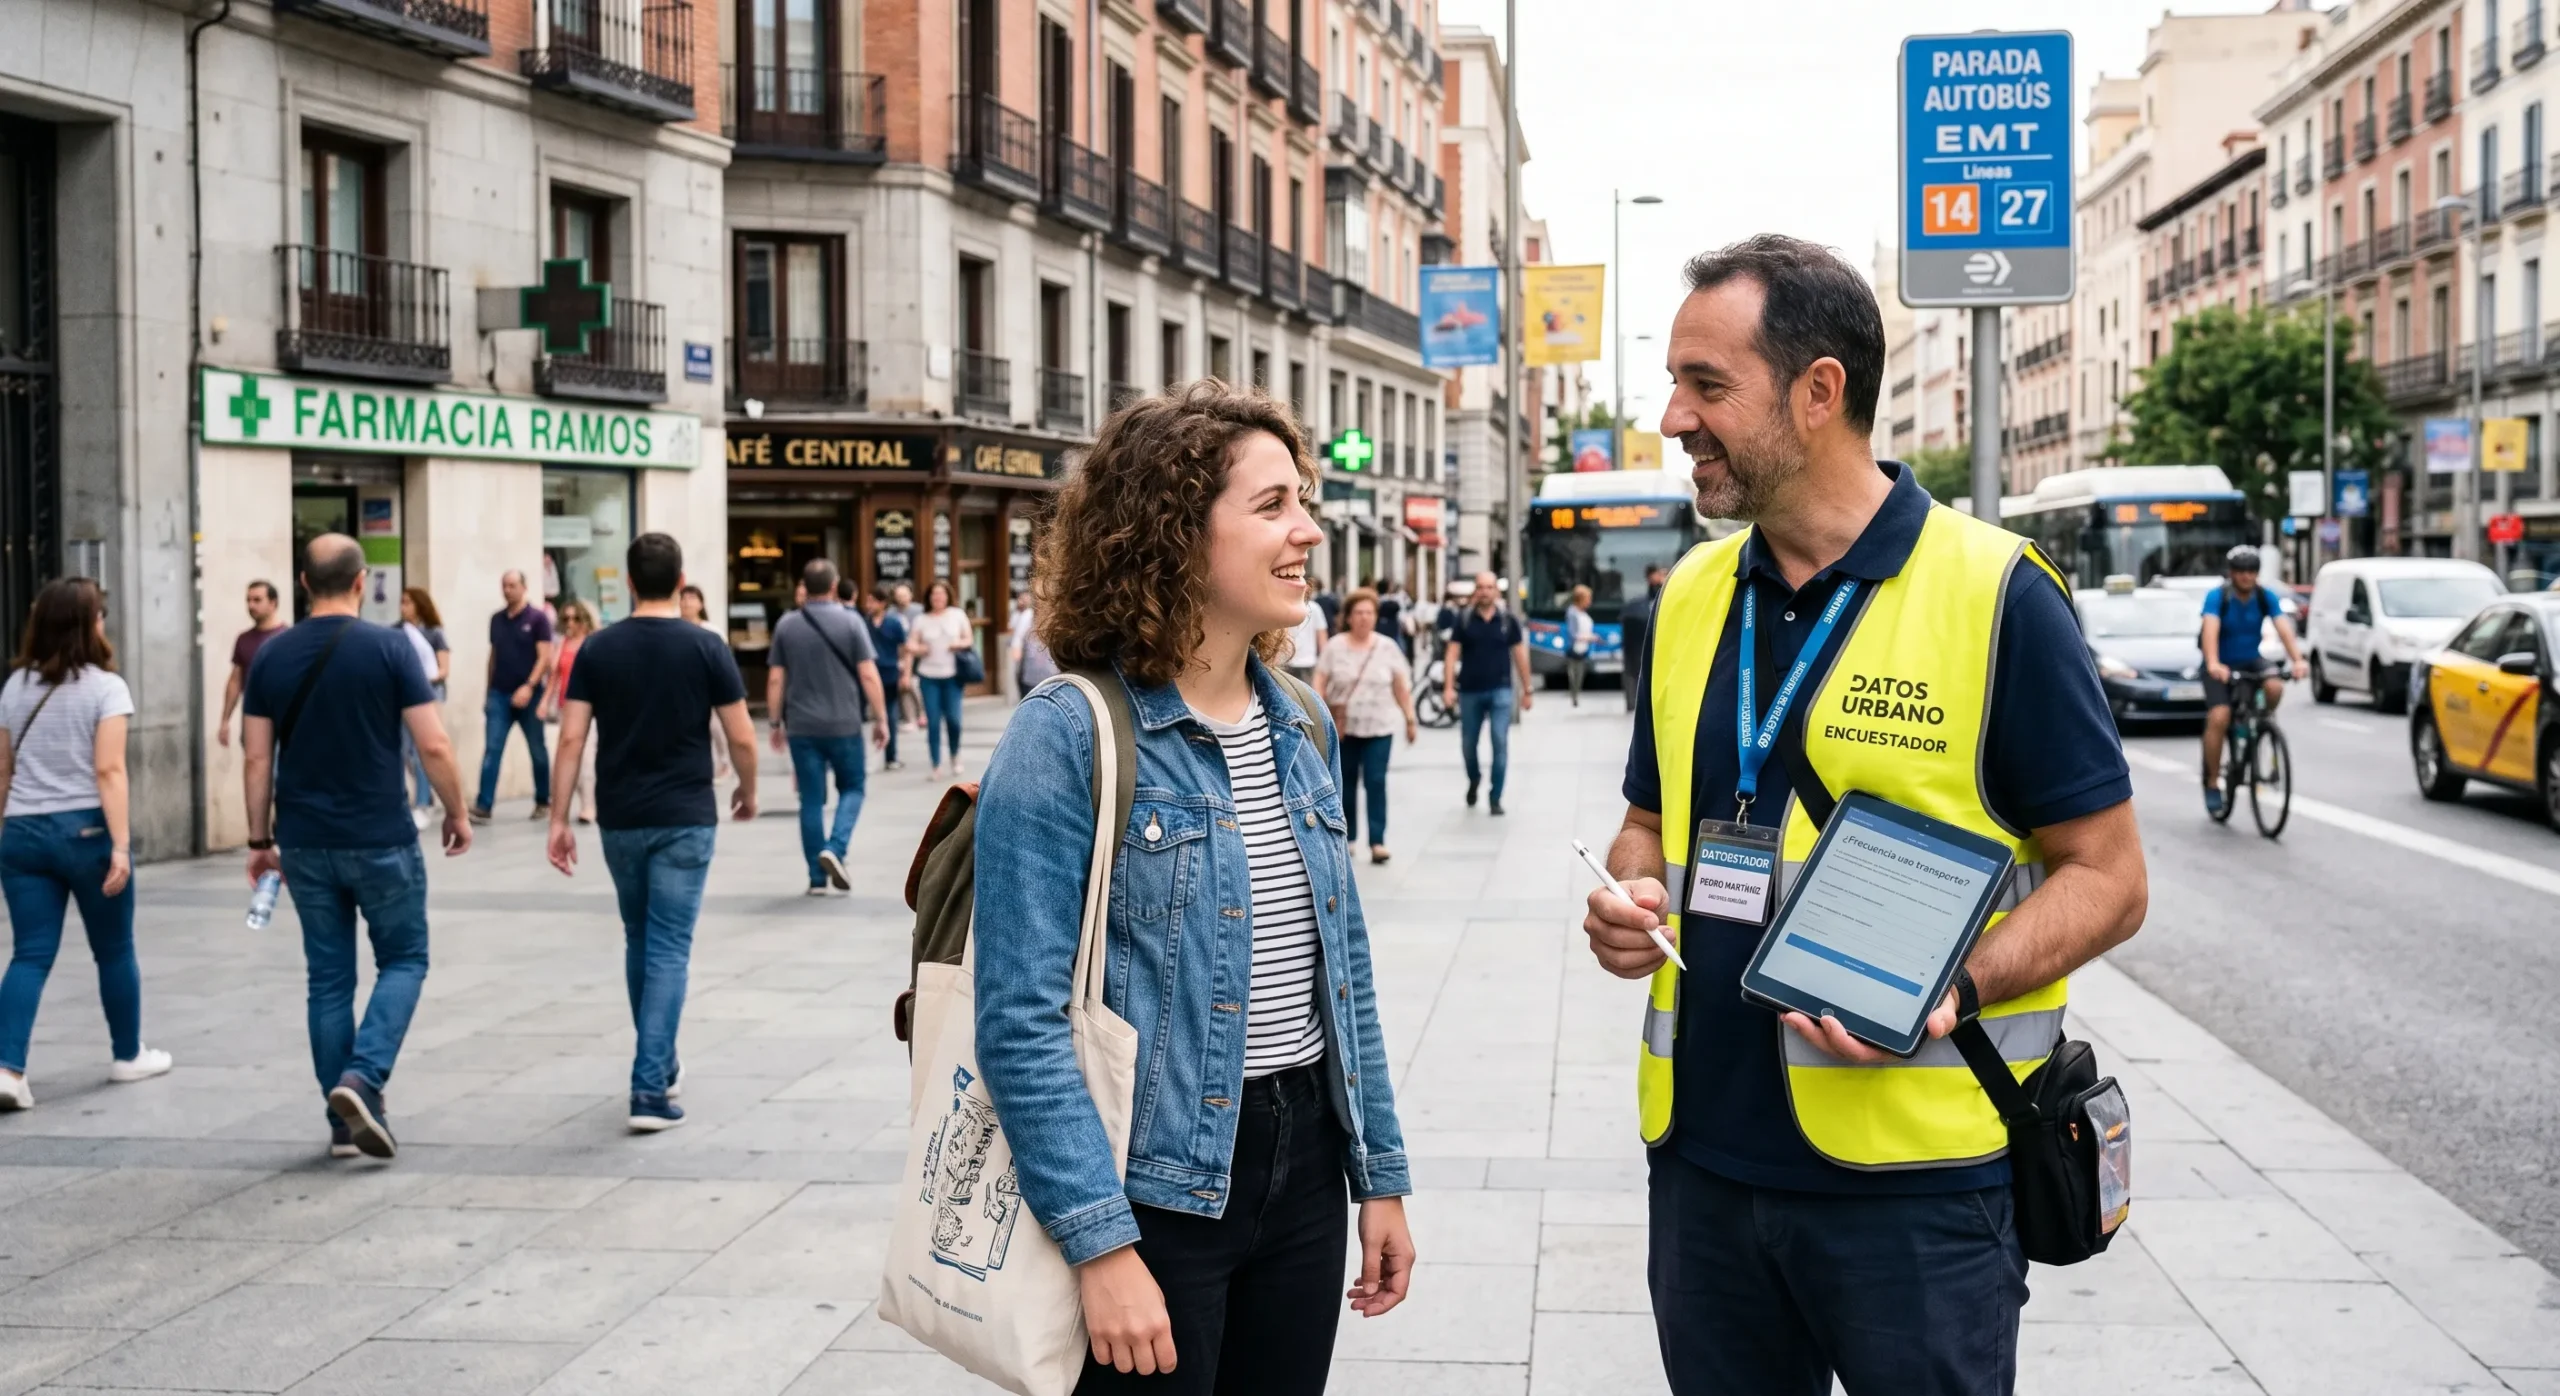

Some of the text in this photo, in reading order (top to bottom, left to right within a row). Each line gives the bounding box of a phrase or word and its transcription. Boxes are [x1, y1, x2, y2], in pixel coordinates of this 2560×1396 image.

[1932, 49, 2043, 78] PARADA
[1923, 77, 2051, 112] AUTOBÚS
[1936, 123, 2039, 153] EMT
[1929, 189, 2047, 228] 14 27
[294, 387, 652, 457] FARMACIA RAMOS
[726, 433, 911, 467] AFÉ CENTRAL
[1849, 674, 1929, 700] DATOS
[1841, 695, 1945, 725] URBANO
[1824, 725, 1947, 753] ENCUESTADOR
[1842, 835, 1897, 860] ¿Frecuencia
[1700, 877, 1724, 888] PEDRO
